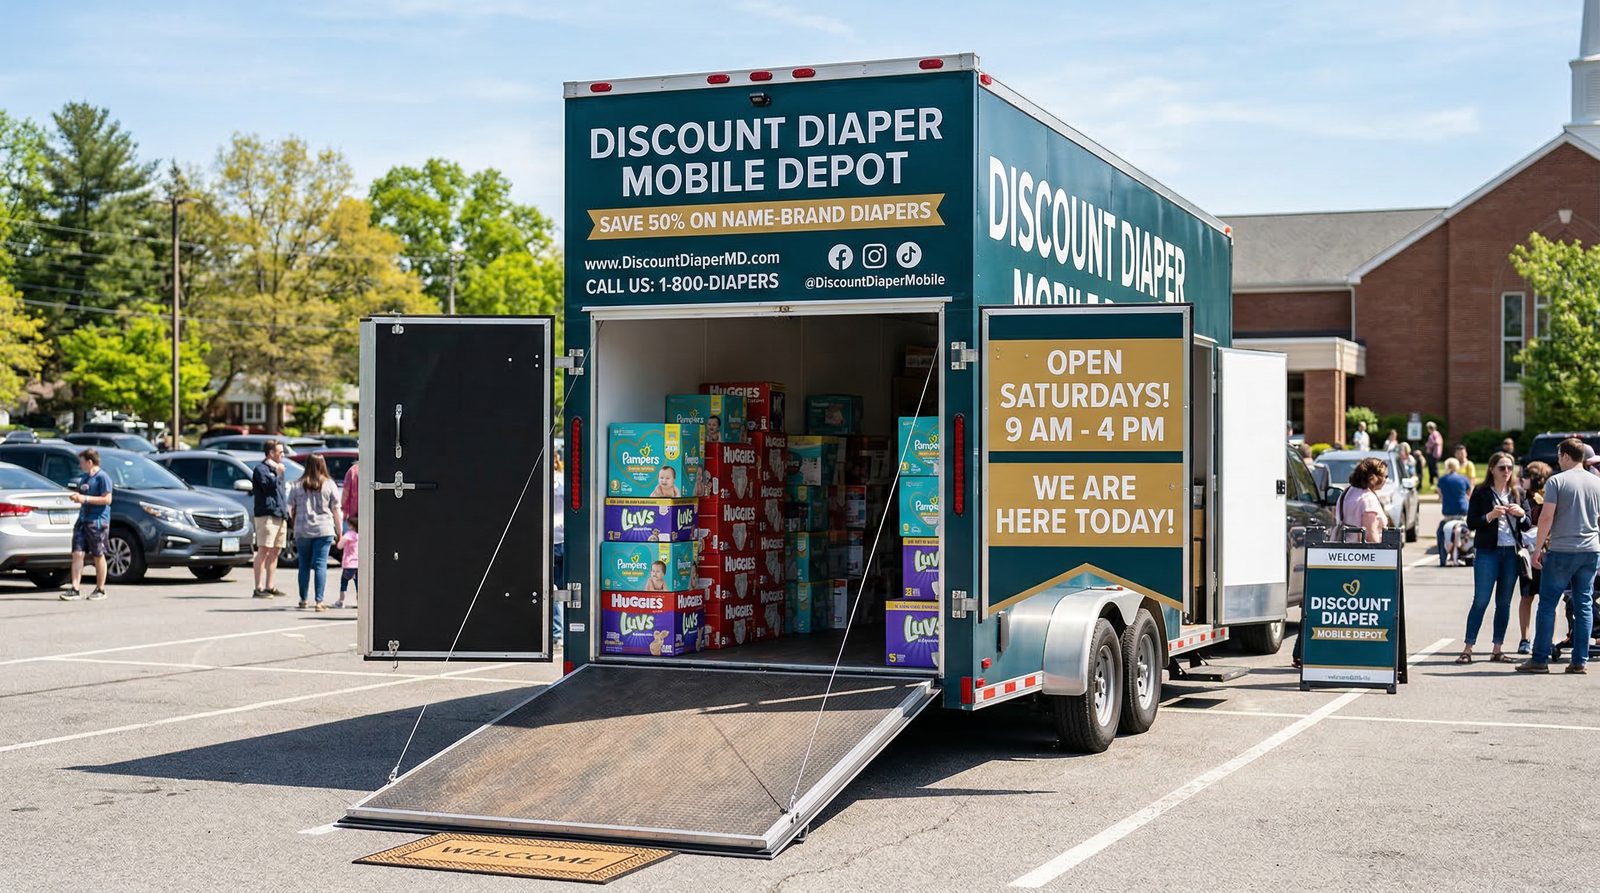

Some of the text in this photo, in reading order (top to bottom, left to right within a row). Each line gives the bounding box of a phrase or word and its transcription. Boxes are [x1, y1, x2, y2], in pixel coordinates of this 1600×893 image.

[590, 107, 943, 160] DISCOUNT DIAPER
[622, 152, 909, 197] MOBILE DEPOT
[599, 202, 931, 233] SAVE 50% ON NAME-BRAND DIAPERS
[989, 156, 1186, 303] DISCOUNT DIAPER
[585, 252, 780, 270] www.DiscountDiaperMD.com
[586, 273, 779, 294] CALL US: 1-800-DIAPERS
[805, 274, 945, 290] @DiscountDiaperMobile
[1047, 349, 1122, 375] OPEN
[1000, 383, 1170, 409] SATURDAYS!
[1005, 416, 1022, 442] 9
[1030, 417, 1073, 441] AM
[1097, 416, 1114, 441] 4
[1123, 416, 1164, 441] PM
[622, 452, 660, 465] Pampers
[1033, 475, 1136, 500] WE ARE
[996, 508, 1173, 534] HERE TODAY!
[617, 558, 647, 571] Pampers
[1328, 552, 1376, 562] WELCOME
[611, 593, 663, 609] HUGGIES
[1311, 597, 1391, 611] DISCOUNT
[1321, 612, 1378, 626] DIAPER
[1317, 629, 1383, 640] MOBILE DEPOT
[441, 846, 605, 865] WELCOME
